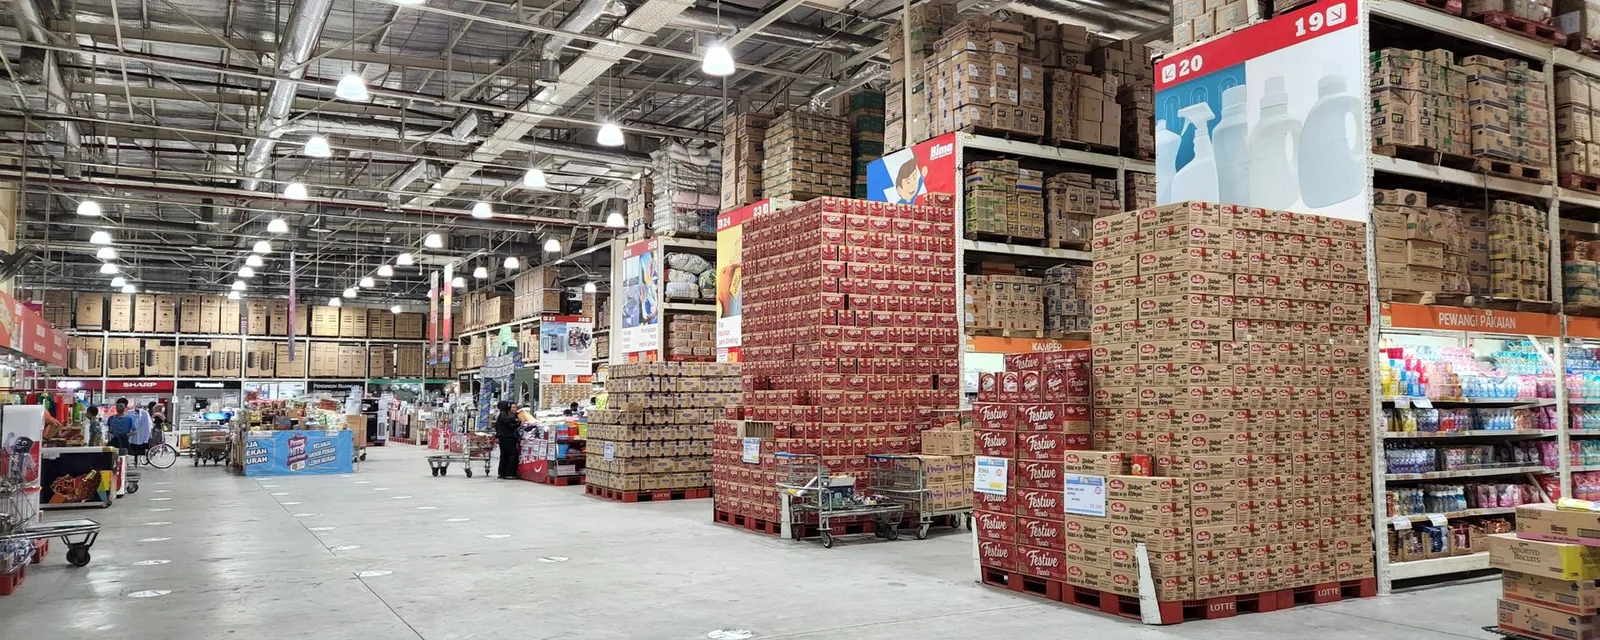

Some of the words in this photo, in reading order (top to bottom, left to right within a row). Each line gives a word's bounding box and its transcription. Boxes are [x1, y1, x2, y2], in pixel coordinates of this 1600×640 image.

[1295, 12, 1323, 37] 19
[1179, 55, 1203, 77] 20
[930, 143, 953, 160] Bima
[753, 206, 762, 217] 23
[723, 217, 730, 227] 24
[1438, 312, 1478, 326] PEWANGI
[1480, 315, 1516, 328] PAKAIAN
[1032, 342, 1062, 351] KAMPER
[1012, 355, 1039, 370] Festive
[980, 406, 1008, 422] Festive
[1025, 405, 1055, 423] Festive
[981, 433, 1007, 450] Festive
[1026, 435, 1056, 452] Festive
[290, 445, 304, 456] HITS
[1026, 463, 1056, 479] Festive
[1025, 492, 1056, 509] Festive
[980, 514, 1007, 529] Festive
[1027, 521, 1057, 537] Festive
[981, 542, 1008, 557] Festive
[1510, 545, 1540, 556] ASSORTED
[1026, 548, 1058, 568] Festive
[1514, 553, 1540, 563] BISCUITS
[1318, 588, 1340, 596] LOTTE
[1210, 603, 1235, 611] LOTTE
